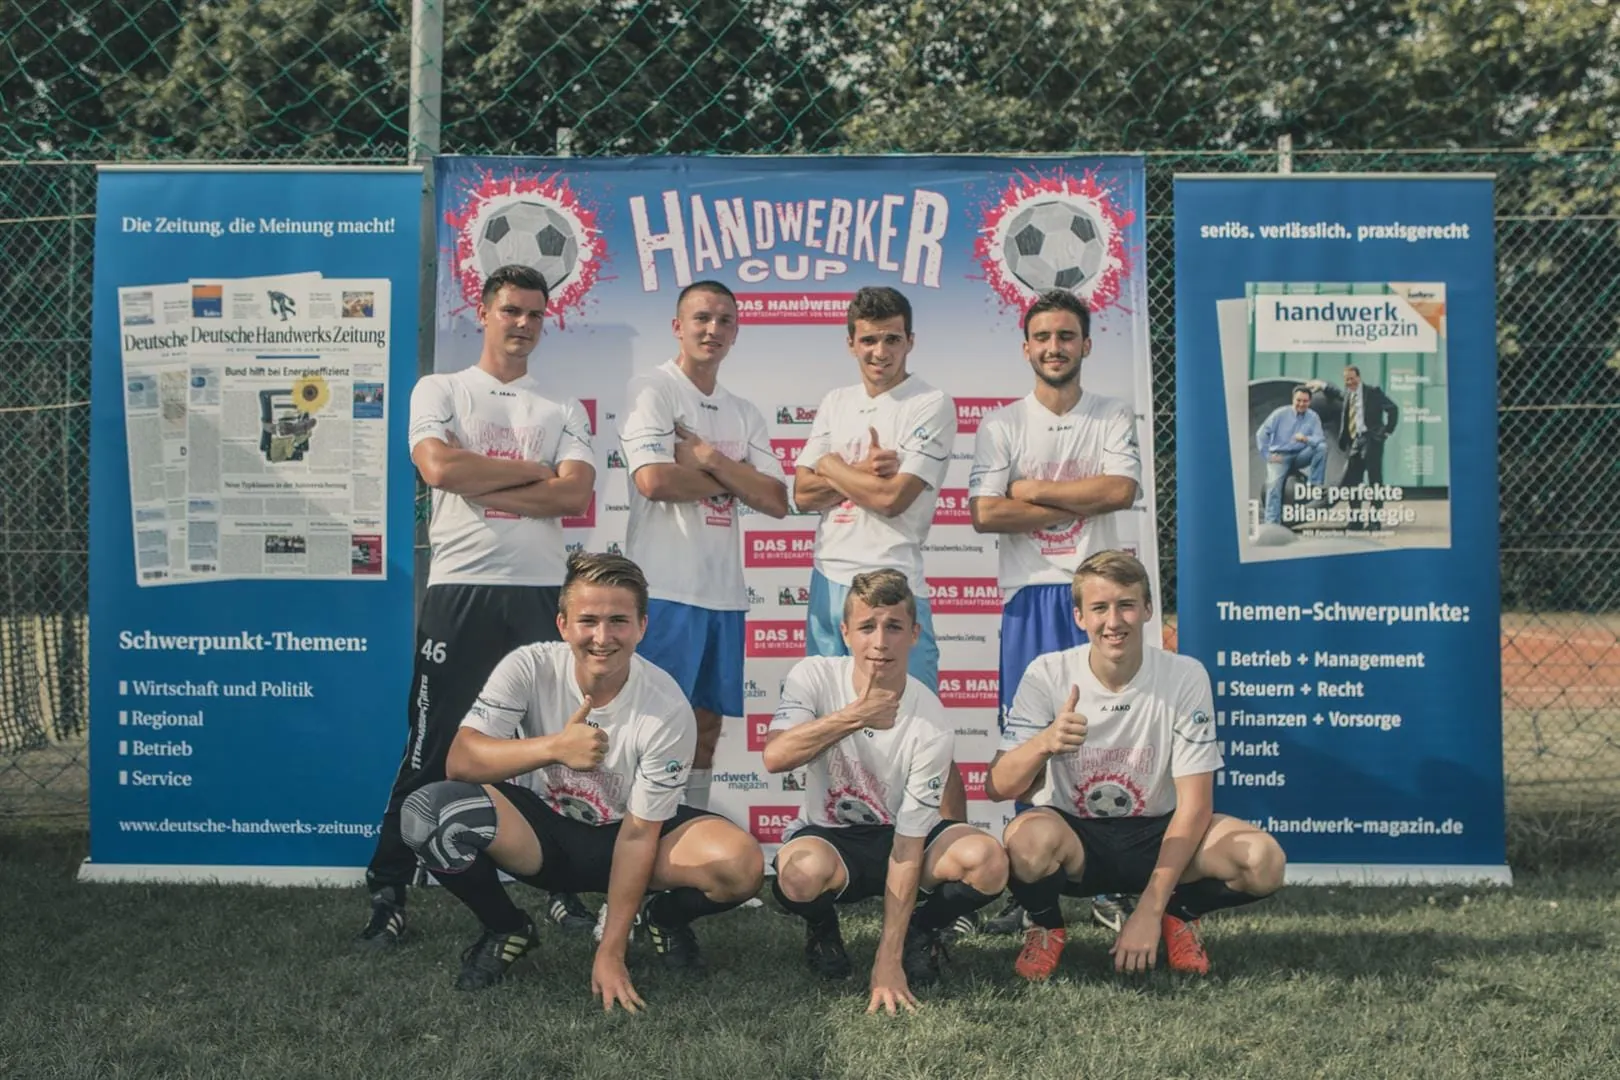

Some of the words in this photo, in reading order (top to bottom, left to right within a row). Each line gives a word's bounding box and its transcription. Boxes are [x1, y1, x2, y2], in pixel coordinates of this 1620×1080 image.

[121, 217, 151, 233] Die
[154, 217, 225, 237] Zeitung,
[228, 217, 256, 234] die
[258, 218, 335, 237] Meinung
[337, 217, 395, 234] macht!
[1357, 222, 1470, 242] praxisgerecht
[629, 188, 949, 291] HANDWERKER
[737, 254, 848, 283] CUP
[1274, 302, 1398, 321] handwerk
[191, 326, 255, 344] Deutsche
[1335, 319, 1418, 341] magazin
[124, 330, 189, 351] Deutsche
[224, 366, 247, 376] Bund
[267, 365, 281, 376] bei
[1294, 483, 1322, 501] Die
[1328, 482, 1404, 503] perfekte
[1281, 504, 1416, 526] Bilanzstrategie
[753, 539, 787, 552] DAS
[1217, 601, 1470, 625] Themen-Schwerpunkte:
[119, 630, 368, 655] Schwerpunkt-Themen:
[753, 628, 788, 641] DAS
[420, 638, 448, 664] 46
[1230, 650, 1292, 667] Betrieb
[1297, 654, 1309, 665] +
[1314, 651, 1425, 671] Management
[131, 680, 218, 697] Wirtschaft
[223, 680, 257, 697] und
[260, 681, 314, 698] Politik
[1230, 681, 1294, 698] Steuern
[1300, 684, 1312, 696] +
[1317, 681, 1364, 698] Recht
[131, 710, 204, 730] Regional
[1230, 711, 1307, 728] Finanzen
[1312, 715, 1324, 727] +
[1329, 711, 1402, 731] Vorsorge
[132, 740, 193, 757] Betrieb
[1230, 741, 1280, 757] Markt
[131, 770, 193, 787] Service
[1229, 771, 1286, 787] Trends
